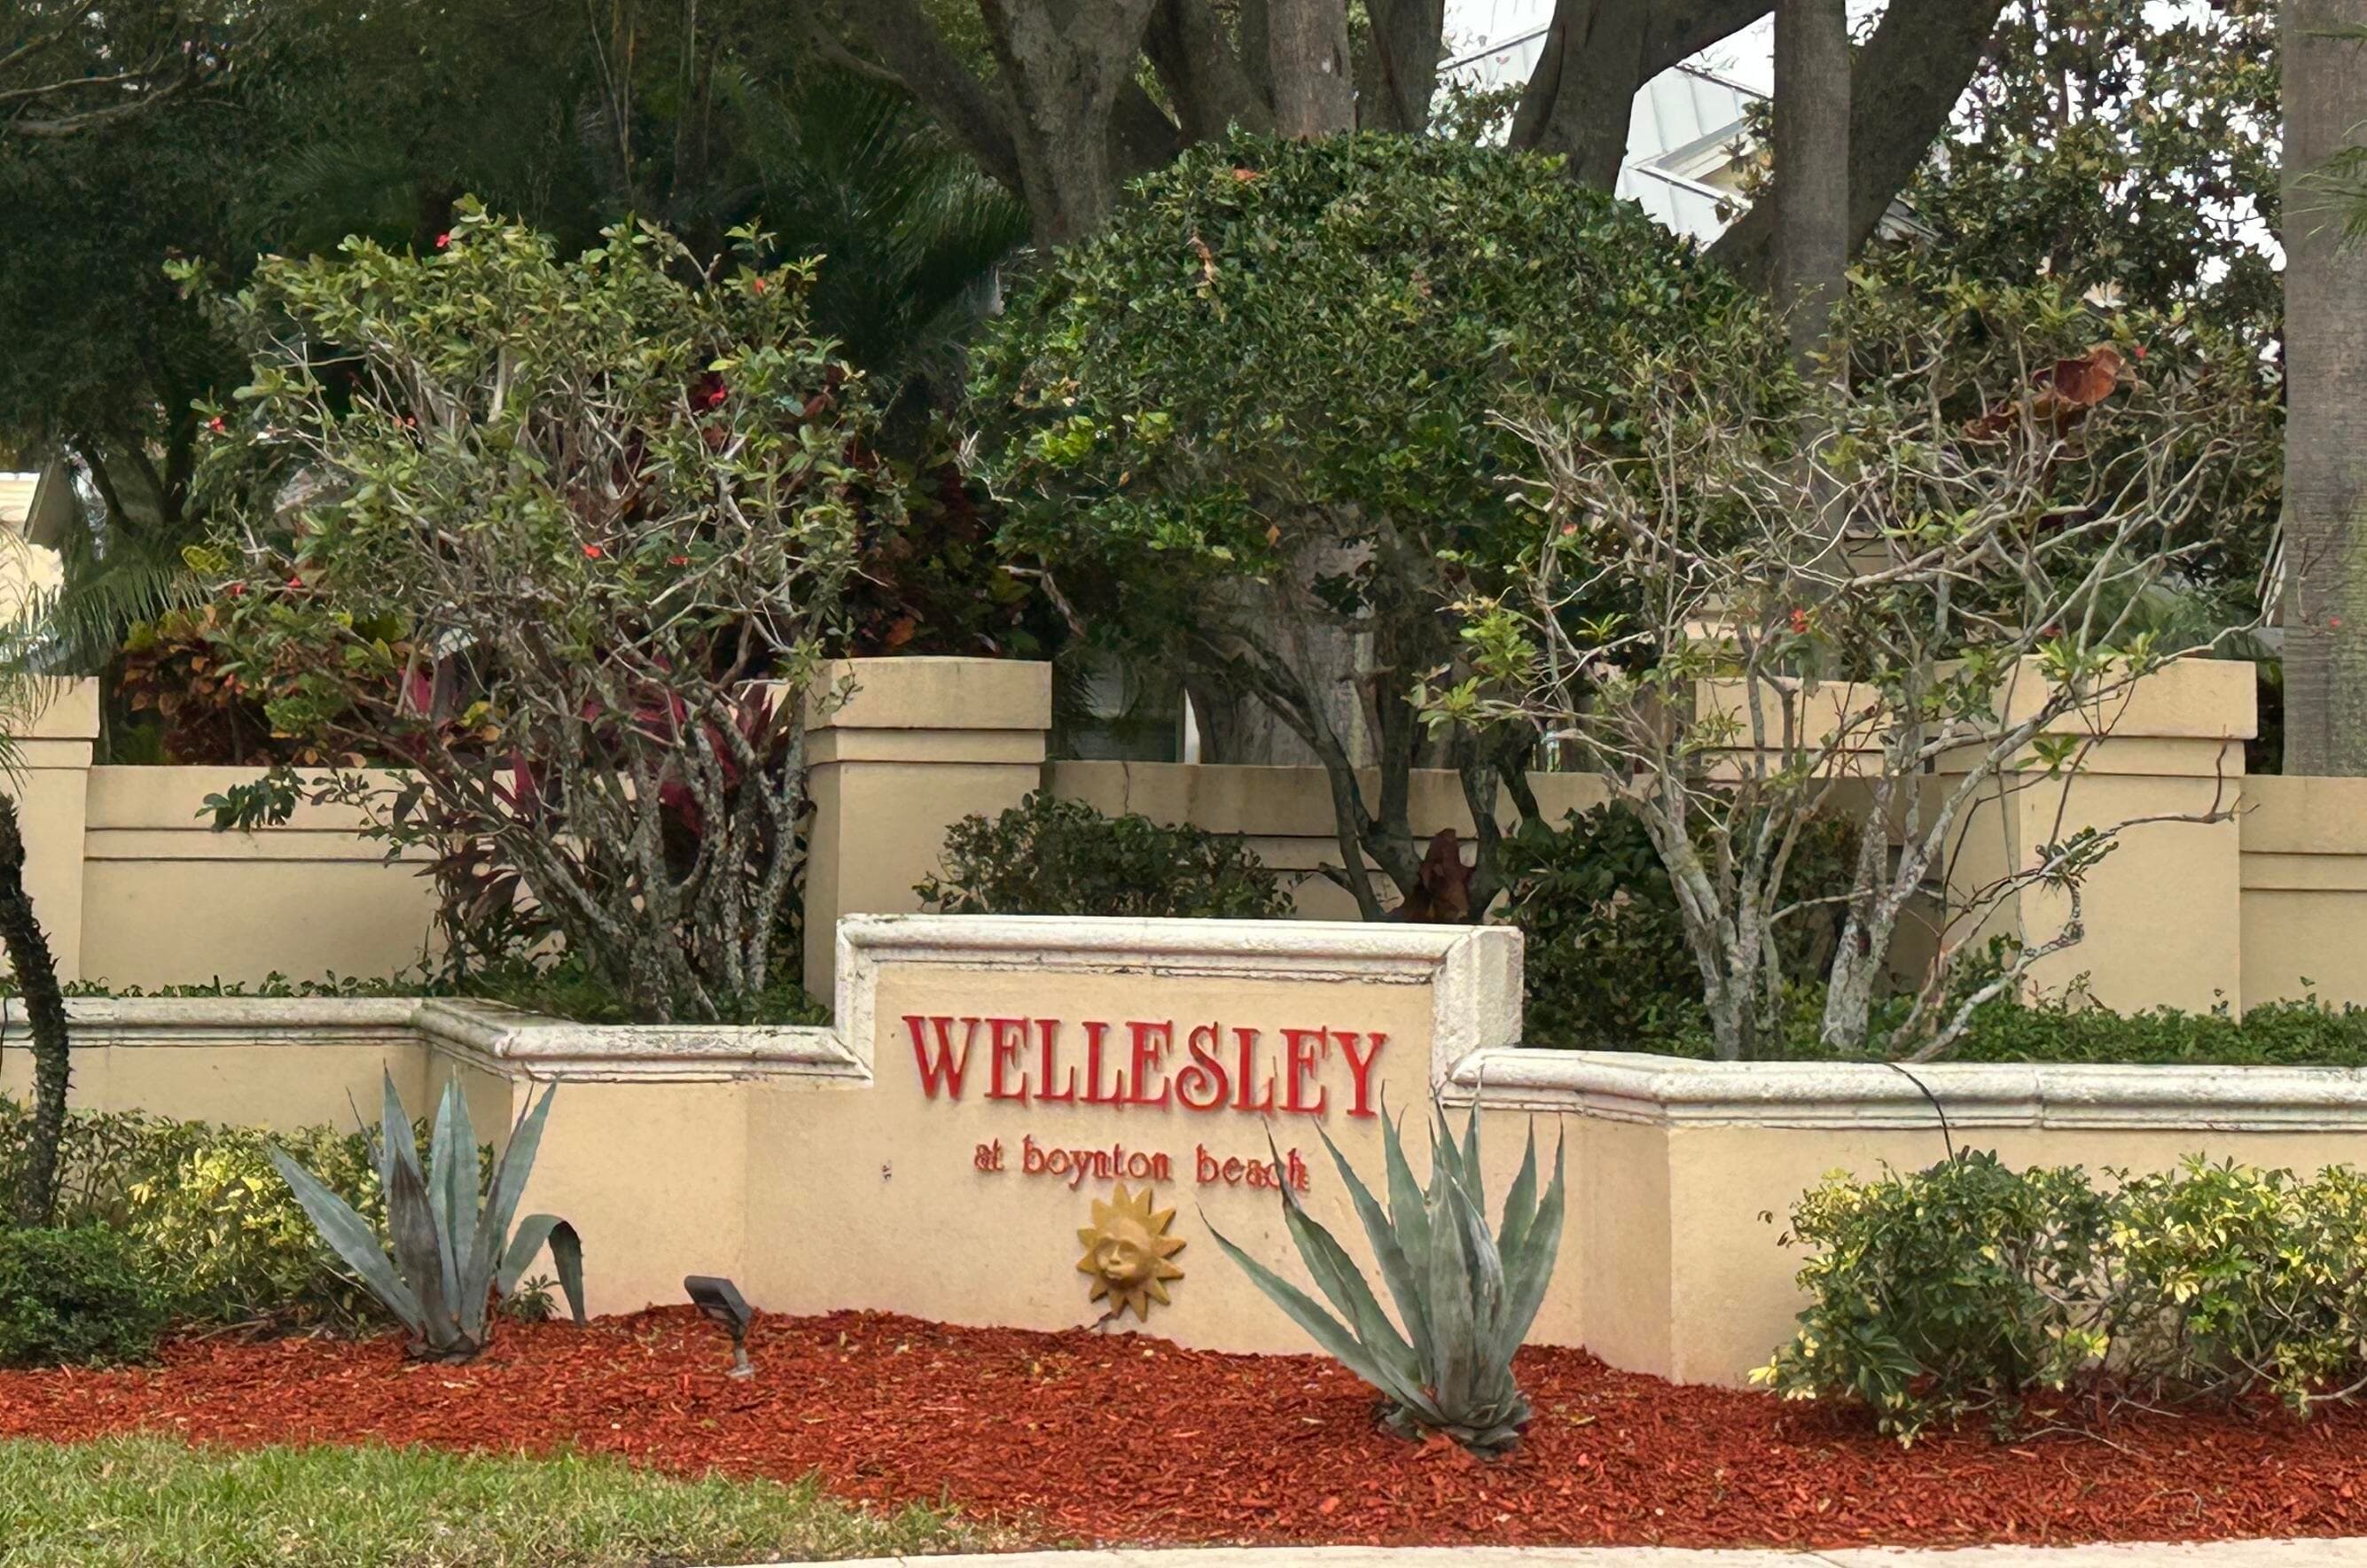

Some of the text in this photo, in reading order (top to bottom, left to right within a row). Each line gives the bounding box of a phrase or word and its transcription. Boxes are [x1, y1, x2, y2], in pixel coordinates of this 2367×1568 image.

[902, 1015, 1389, 1118] WELLESLEY
[974, 1134, 1310, 1192] at boynton beach
